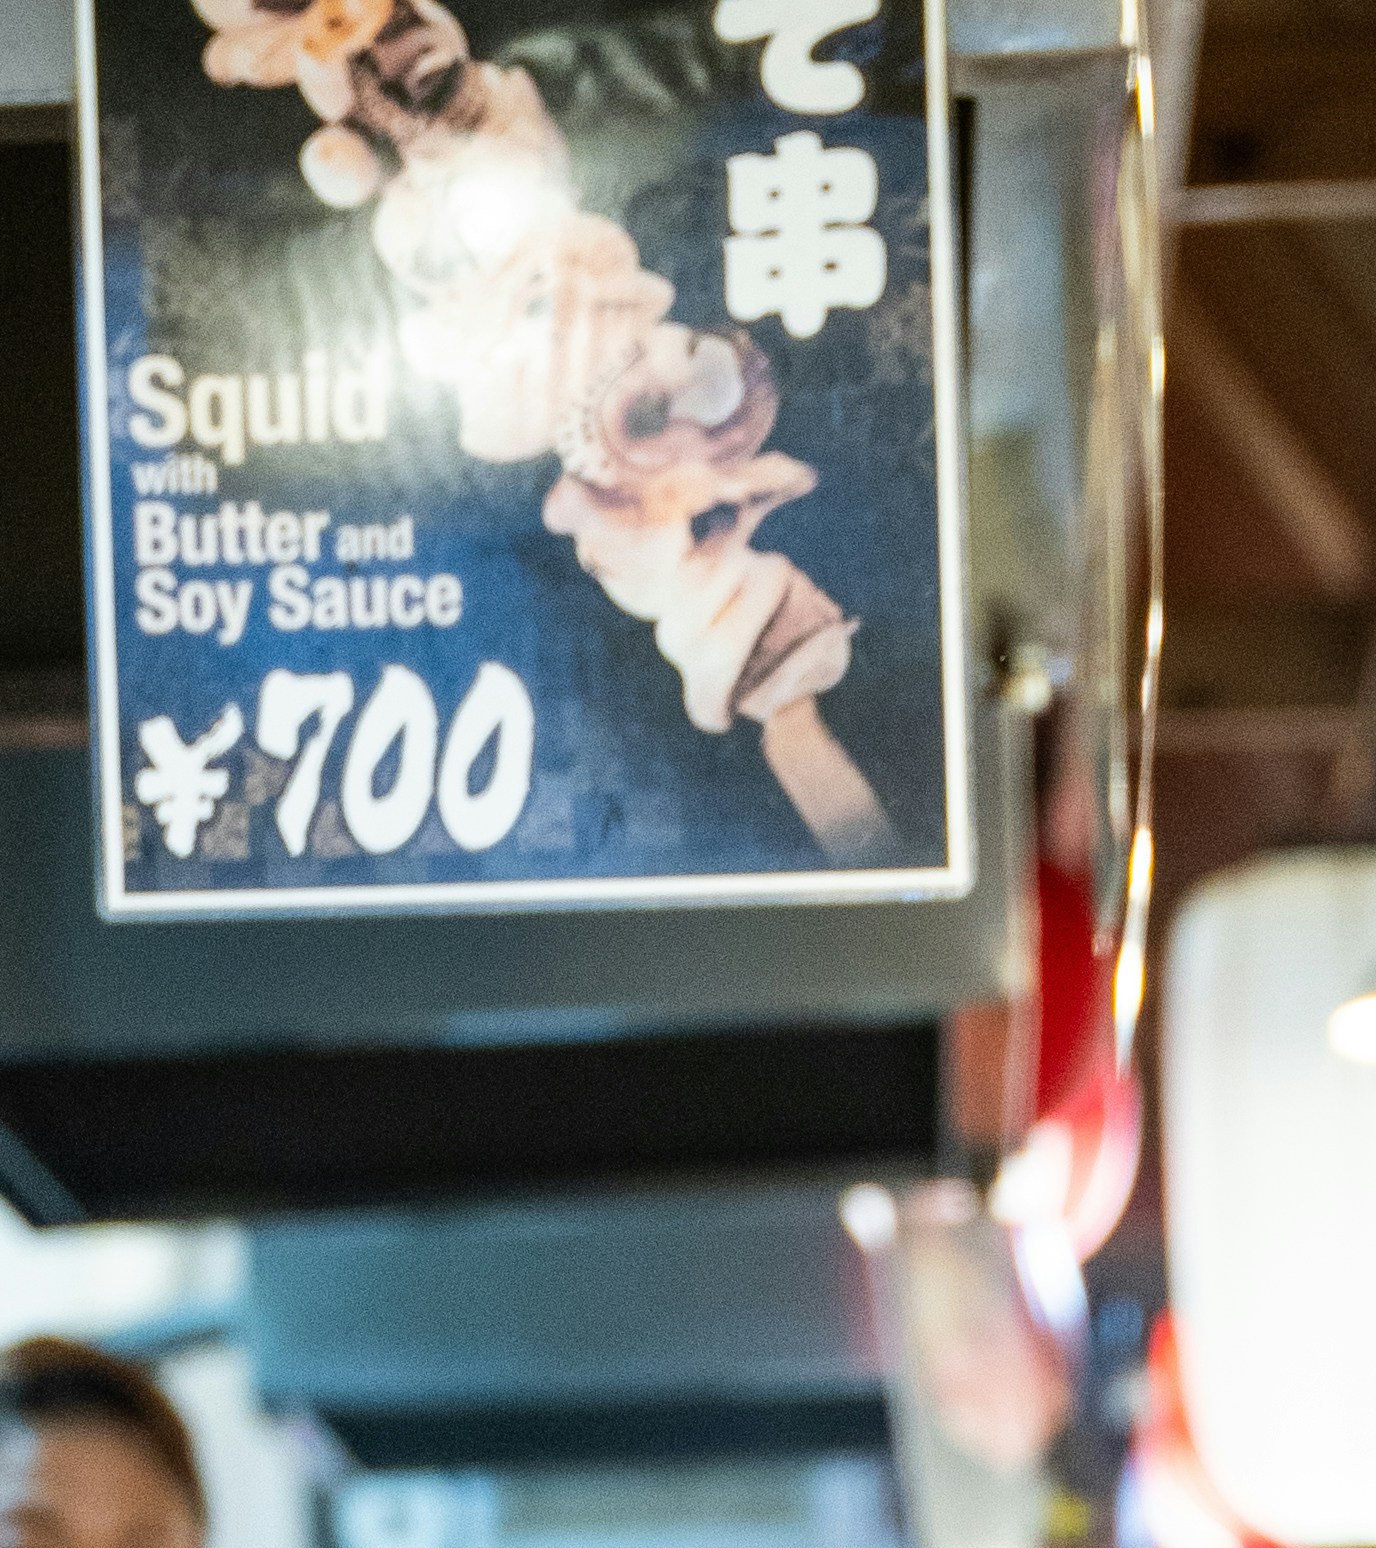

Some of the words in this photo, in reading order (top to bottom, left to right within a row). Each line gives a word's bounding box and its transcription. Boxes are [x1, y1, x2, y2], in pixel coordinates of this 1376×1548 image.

[127, 343, 390, 467] Squid
[130, 451, 219, 496] with
[134, 500, 331, 567] Butter
[334, 512, 416, 563] and
[135, 564, 254, 648] Soy
[267, 560, 464, 632] Sauce
[135, 661, 535, 858] ¥700
